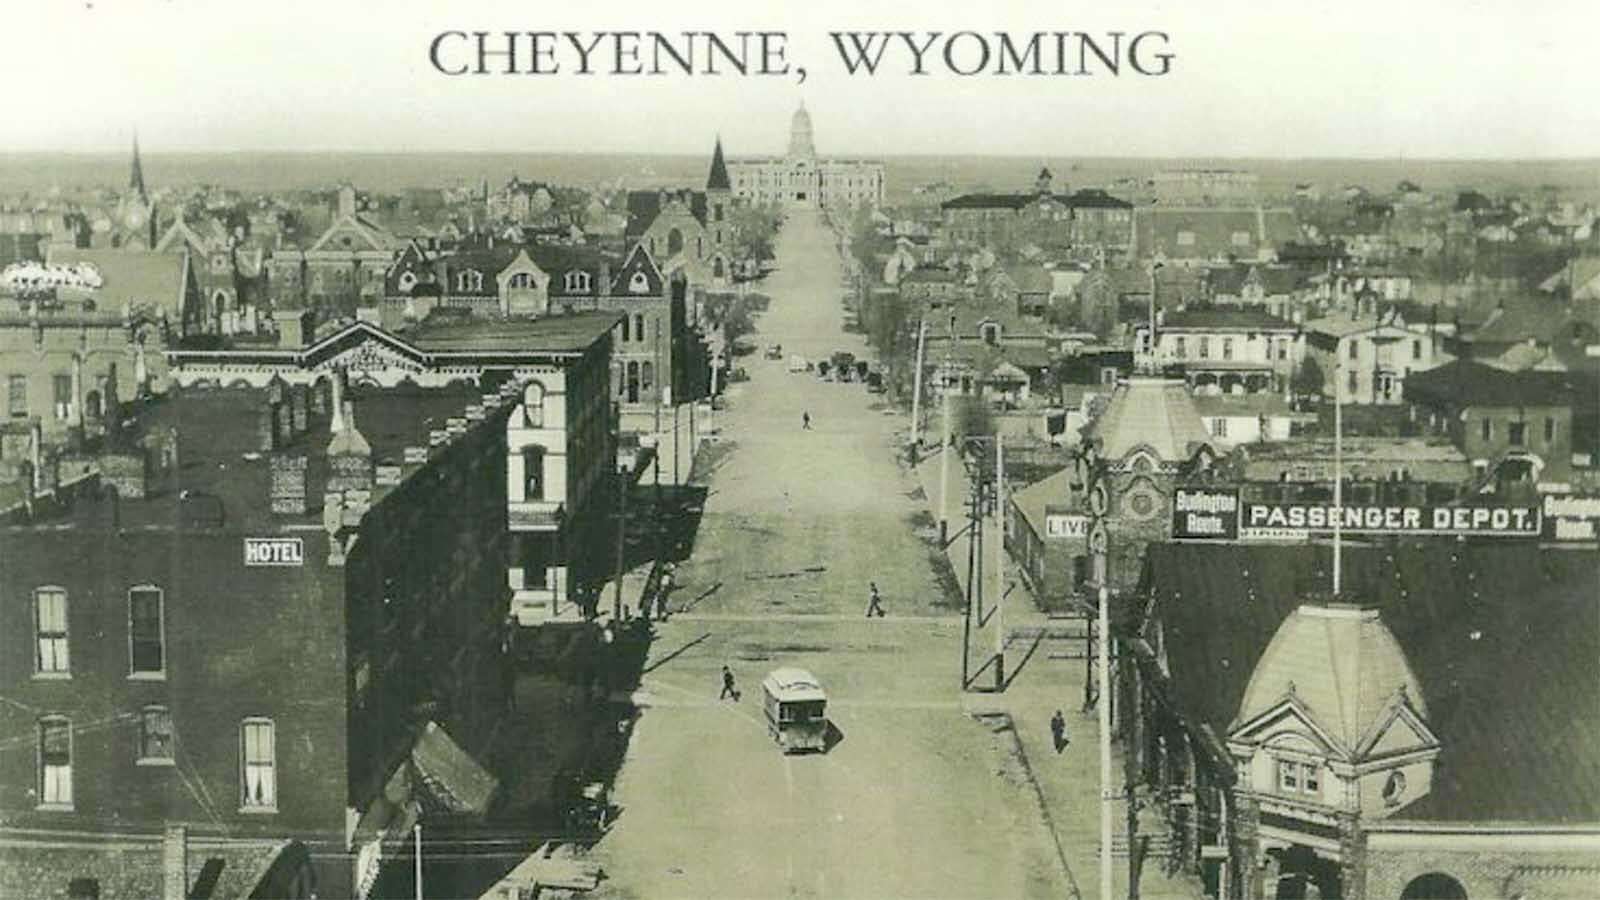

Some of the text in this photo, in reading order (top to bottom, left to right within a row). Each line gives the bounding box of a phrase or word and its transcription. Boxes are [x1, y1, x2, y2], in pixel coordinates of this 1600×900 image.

[1249, 505, 1532, 530] PASSENGER DEPOT.
[247, 542, 302, 561] HOTEL
